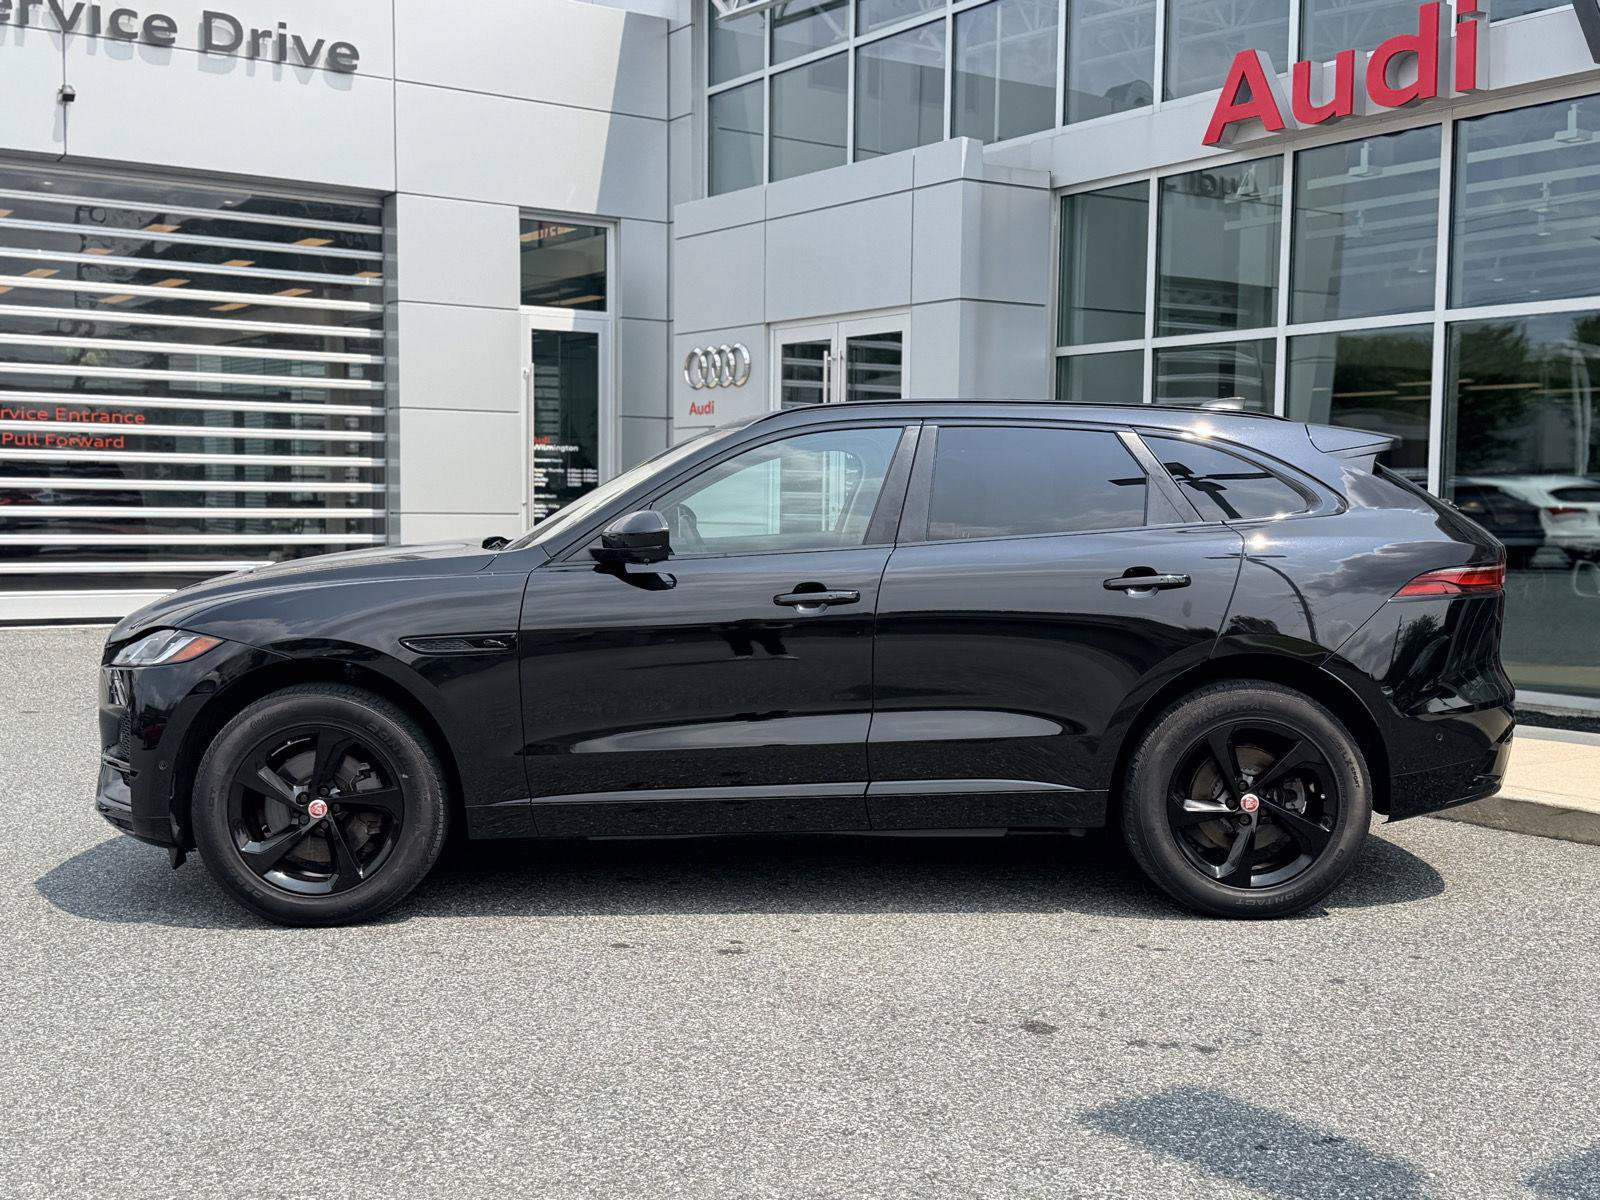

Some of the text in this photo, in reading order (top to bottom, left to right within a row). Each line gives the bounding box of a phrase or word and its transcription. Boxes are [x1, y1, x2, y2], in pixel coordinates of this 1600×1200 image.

[202, 10, 360, 71] Drive
[1202, 0, 1479, 146] Audi
[55, 407, 146, 424] Entrance
[688, 400, 715, 416] Audi
[1, 432, 125, 449] Pull Forward
